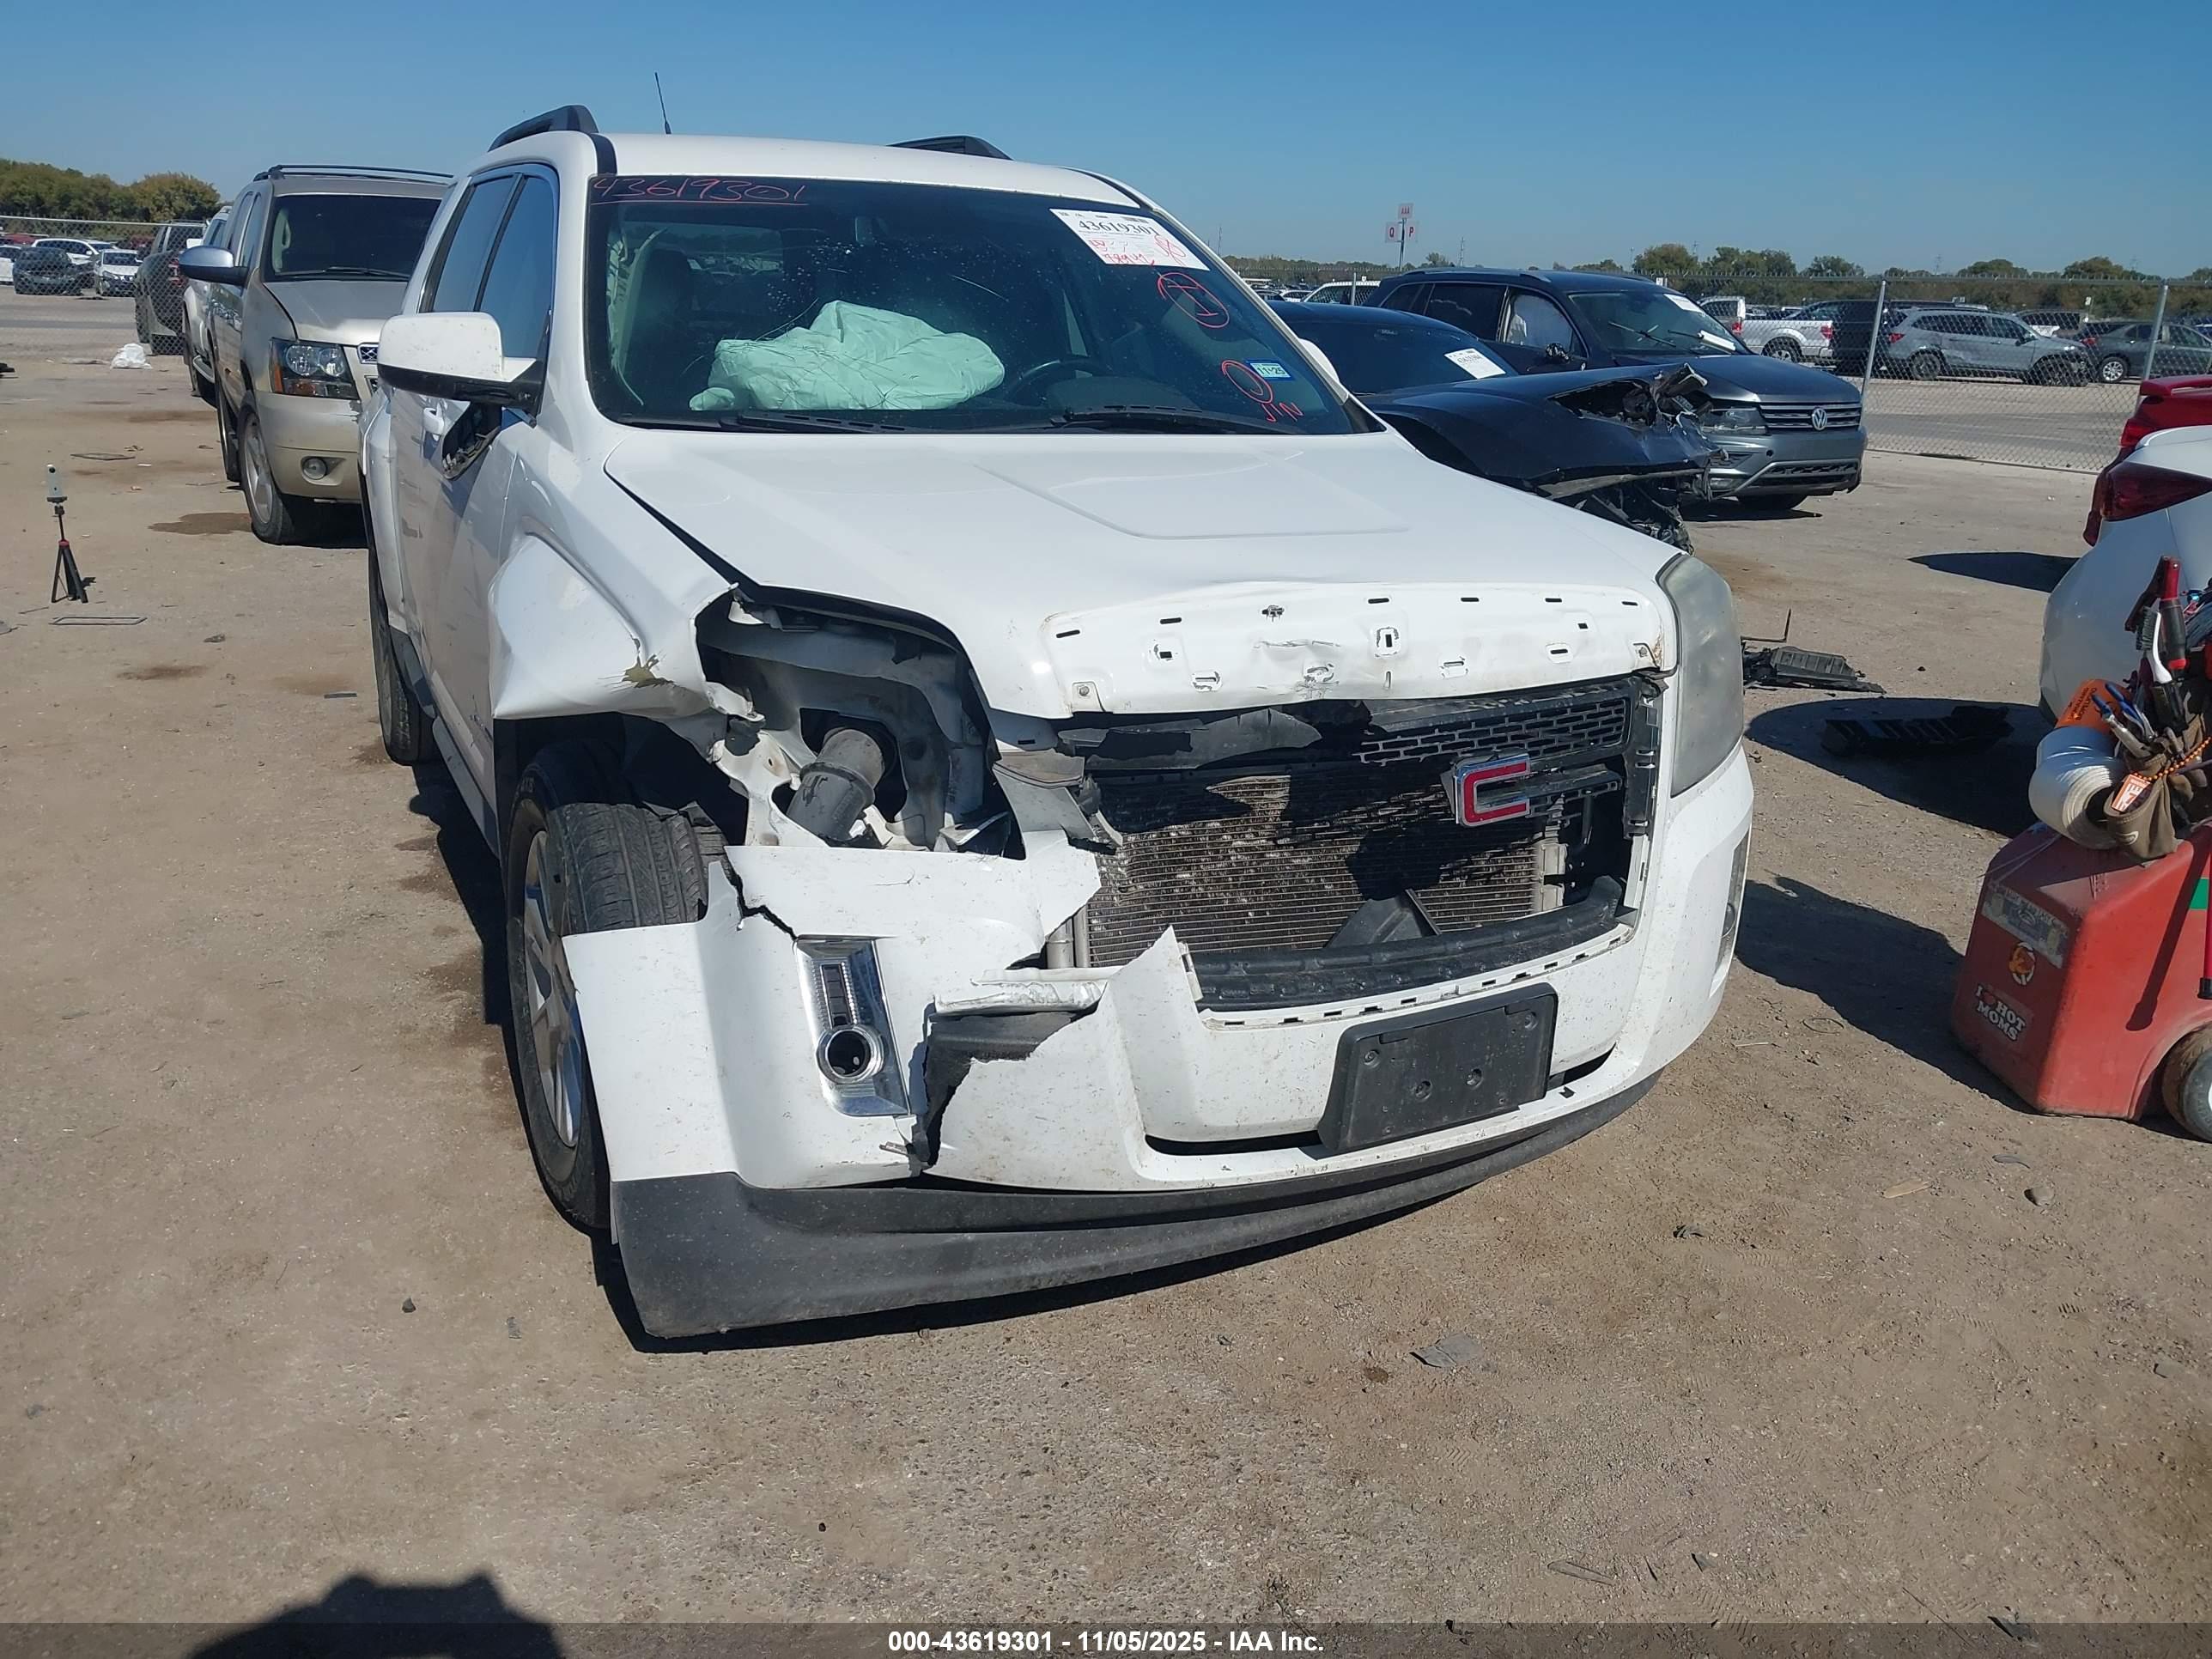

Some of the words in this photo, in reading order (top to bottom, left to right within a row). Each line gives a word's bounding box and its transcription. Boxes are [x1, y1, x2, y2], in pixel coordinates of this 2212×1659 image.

[592, 177, 805, 201] 43619301
[1079, 221, 1162, 236] 43619301
[1975, 985, 1984, 998] I
[1996, 1000, 2026, 1031] HOT
[1977, 1000, 2018, 1041] MOMS
